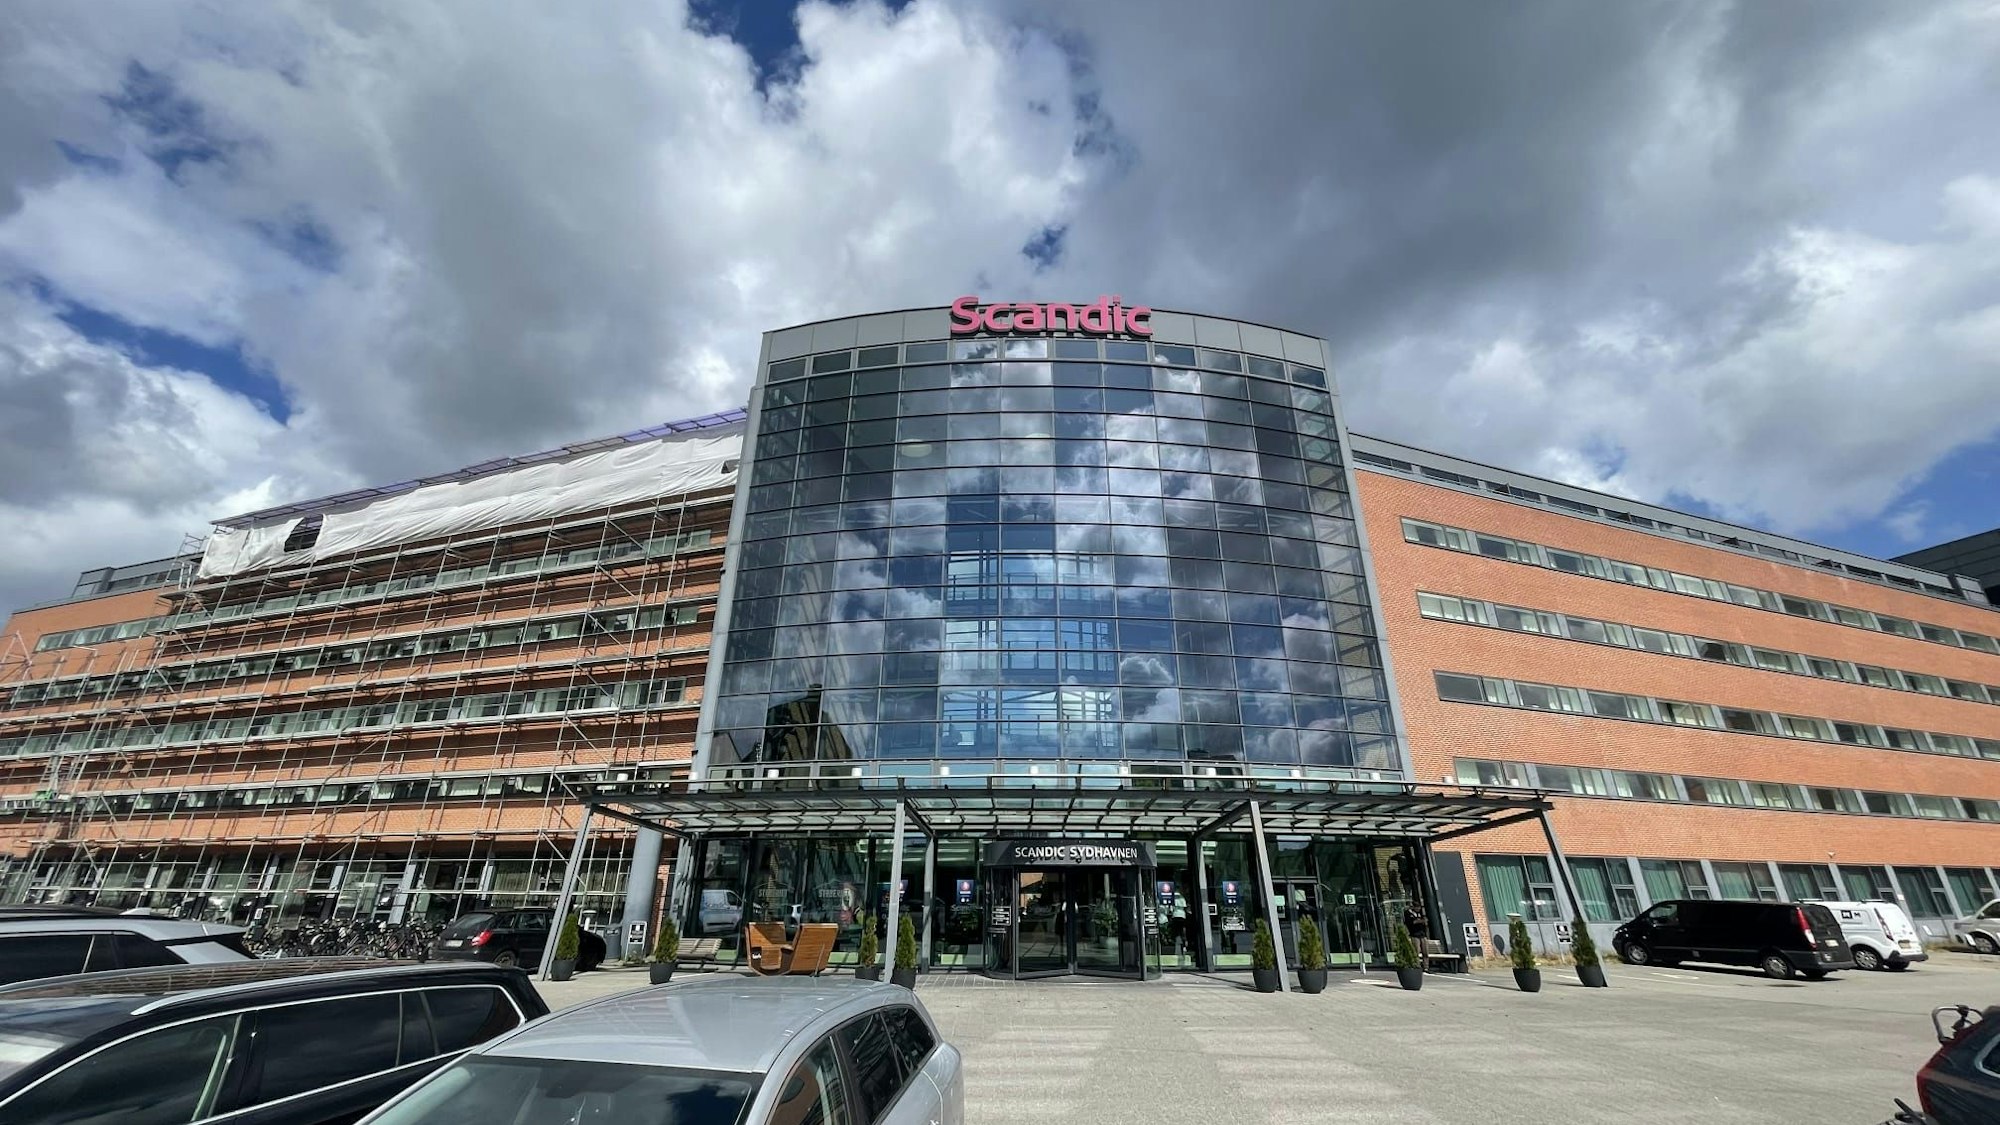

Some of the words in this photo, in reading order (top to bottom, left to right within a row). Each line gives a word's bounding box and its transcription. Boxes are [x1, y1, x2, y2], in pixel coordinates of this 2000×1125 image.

[950, 295, 1153, 336] Scandic
[1015, 847, 1065, 858] SCANDIC
[1070, 846, 1138, 858] SYDHAVNEN
